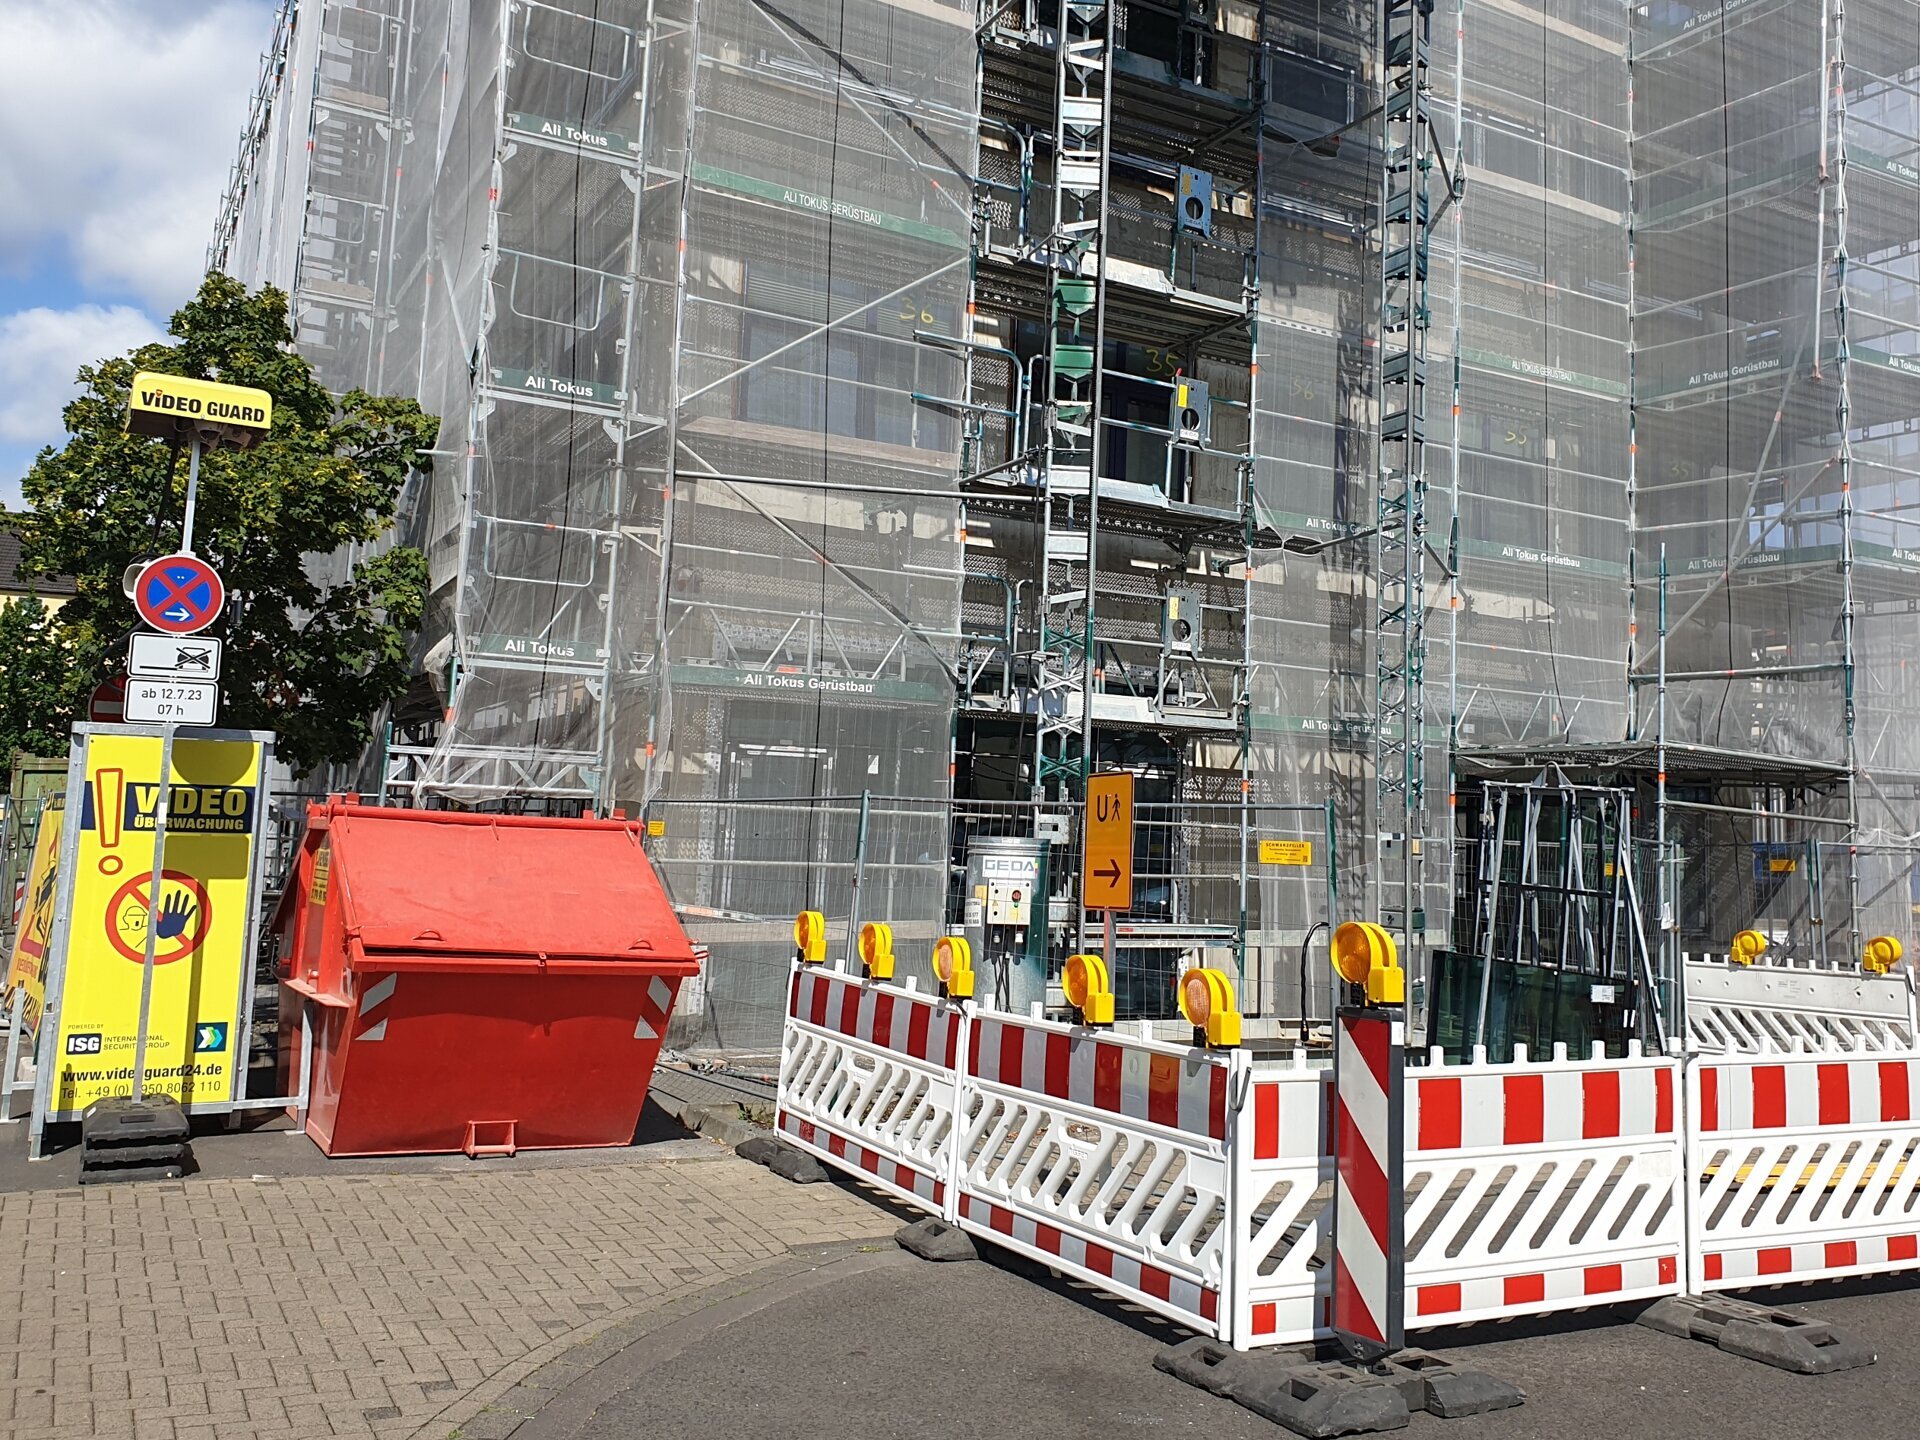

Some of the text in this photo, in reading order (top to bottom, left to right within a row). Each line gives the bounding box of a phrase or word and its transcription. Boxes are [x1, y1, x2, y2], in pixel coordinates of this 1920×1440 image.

[541, 122, 608, 147] Ali Tokus
[783, 190, 882, 225] ALI TOKUS GERÜSTBAU
[1145, 347, 1179, 376] 35
[1688, 359, 1779, 385] Ali Tokus Gerüstbau
[525, 375, 593, 397] Ali Tokus
[206, 401, 265, 422] GUARD
[1306, 517, 1319, 528] Ali
[1320, 519, 1347, 532] Tokus
[1502, 547, 1580, 567] Ali Tokus Gerüstbau
[1731, 553, 1780, 565] Grüstbau
[504, 639, 575, 657] Ali Tokus
[744, 673, 873, 693] Ali Tokus Gerüstbau
[141, 688, 202, 701] ab 12.7.23
[157, 704, 184, 715] 07 h
[1302, 719, 1392, 735] Ali Tokus Gerüstau
[133, 813, 244, 830] ÜBRWACHUNG
[984, 859, 1034, 872] GEDA
[68, 1036, 100, 1052] ISG
[103, 1042, 138, 1050] SECURIT
[104, 1035, 164, 1043] INTERNAONAL
[63, 1064, 222, 1082] www.videguard24.de
[61, 1080, 221, 1099] Tel. +49 (0) 950 8062 110
